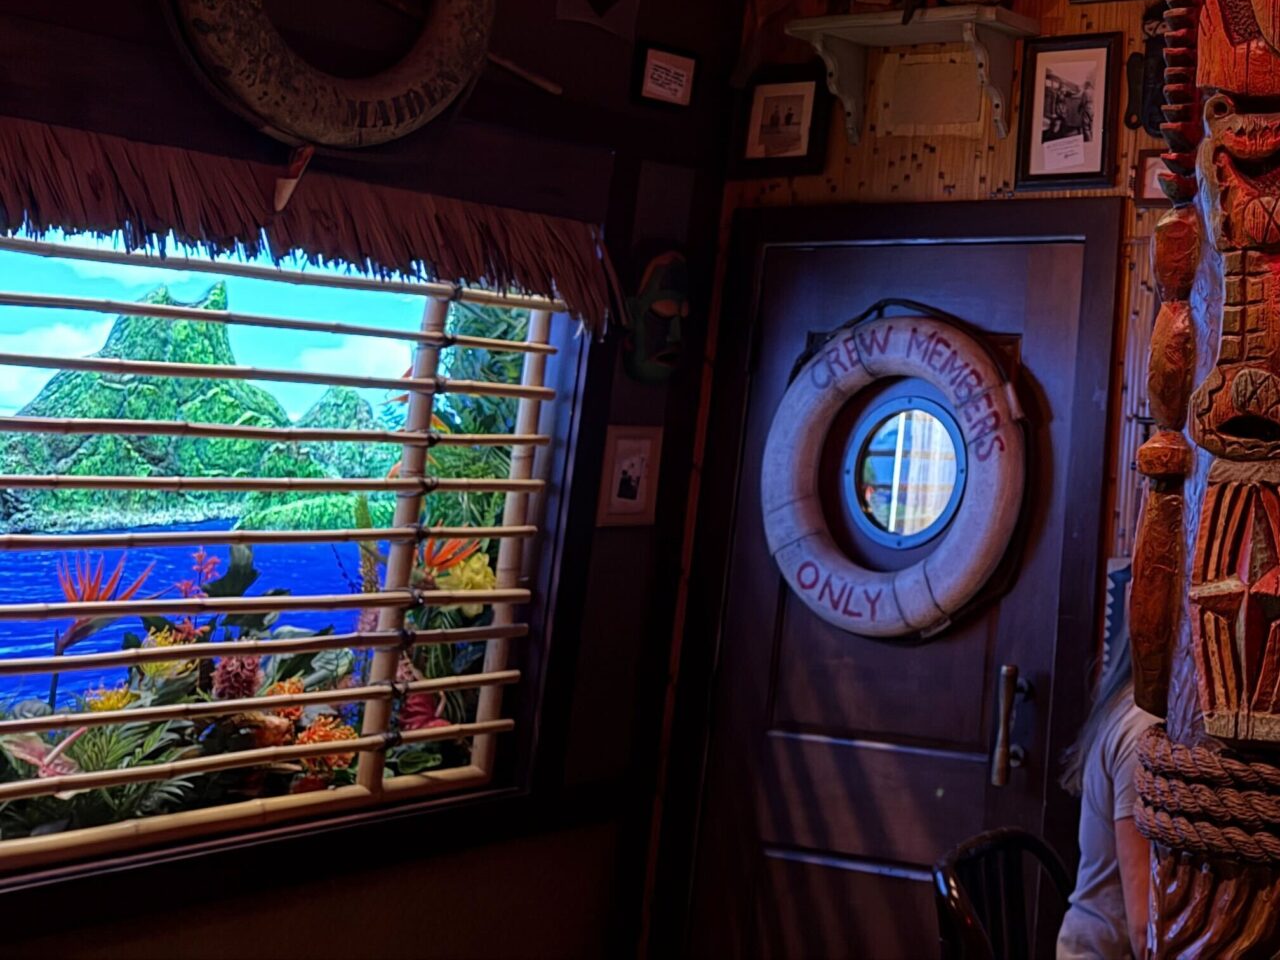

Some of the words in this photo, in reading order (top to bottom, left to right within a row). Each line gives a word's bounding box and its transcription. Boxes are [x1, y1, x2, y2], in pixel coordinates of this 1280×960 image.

[342, 71, 461, 129] MAIDEN
[810, 325, 893, 389] CREW
[906, 327, 1005, 462] MEMBERS
[797, 561, 882, 623] ONLY
